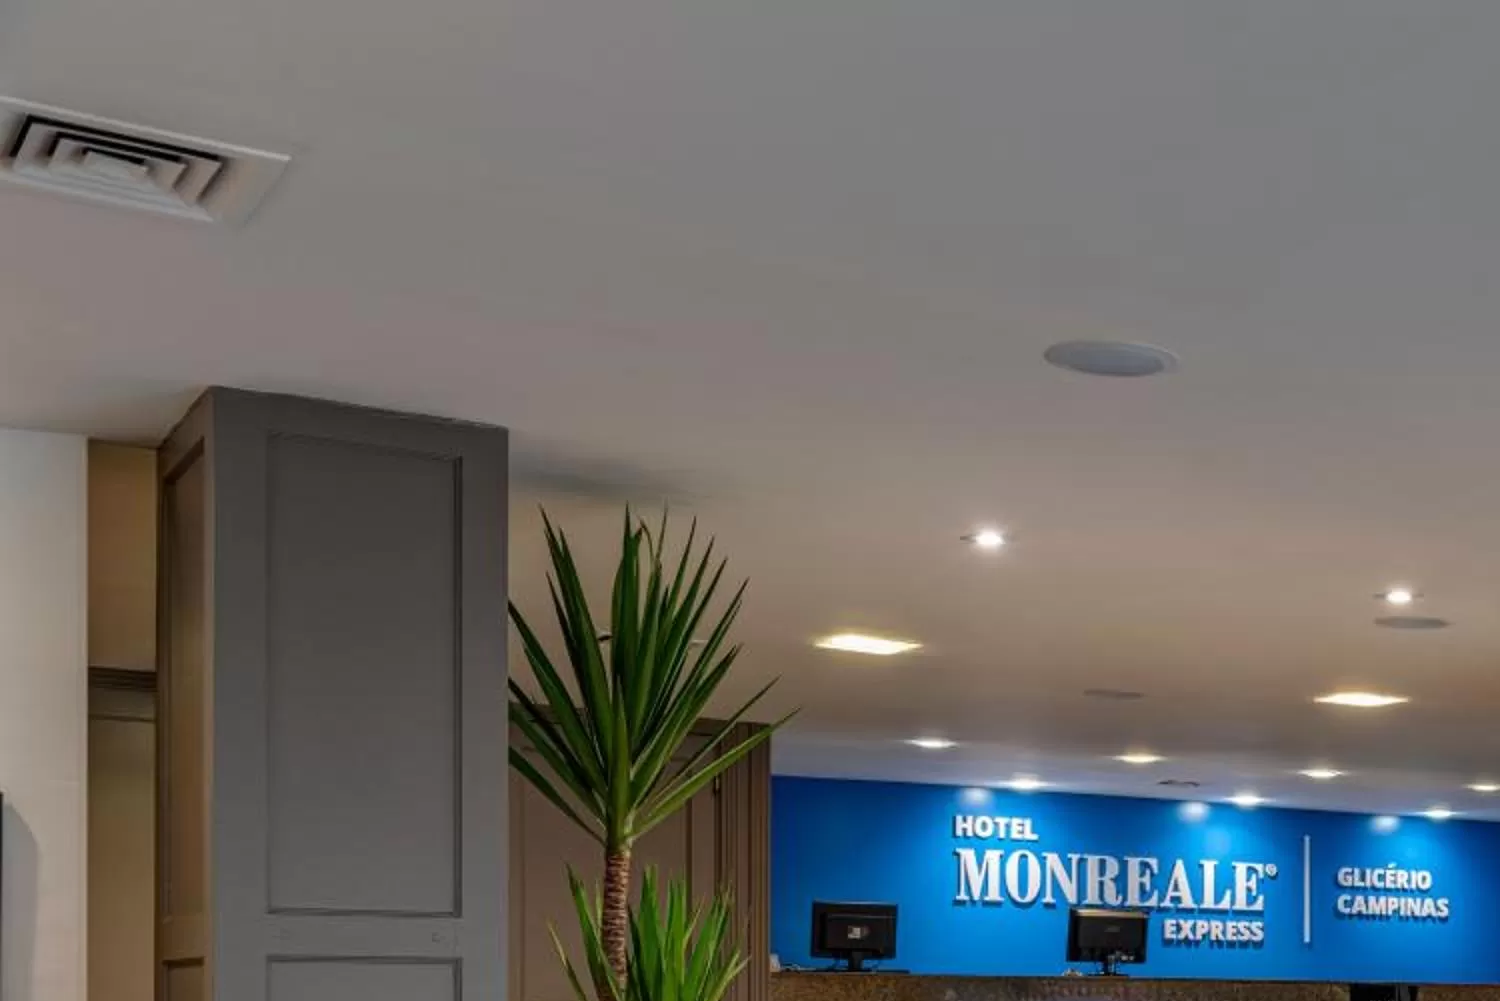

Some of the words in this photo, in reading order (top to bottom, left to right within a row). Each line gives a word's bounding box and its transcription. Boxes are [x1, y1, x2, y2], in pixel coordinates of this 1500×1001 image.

[955, 815, 1039, 841] HOTEL
[1337, 862, 1432, 891] GLICÉRIO
[1337, 894, 1449, 918] CAMPINAS
[1163, 918, 1265, 942] EXPRESS
